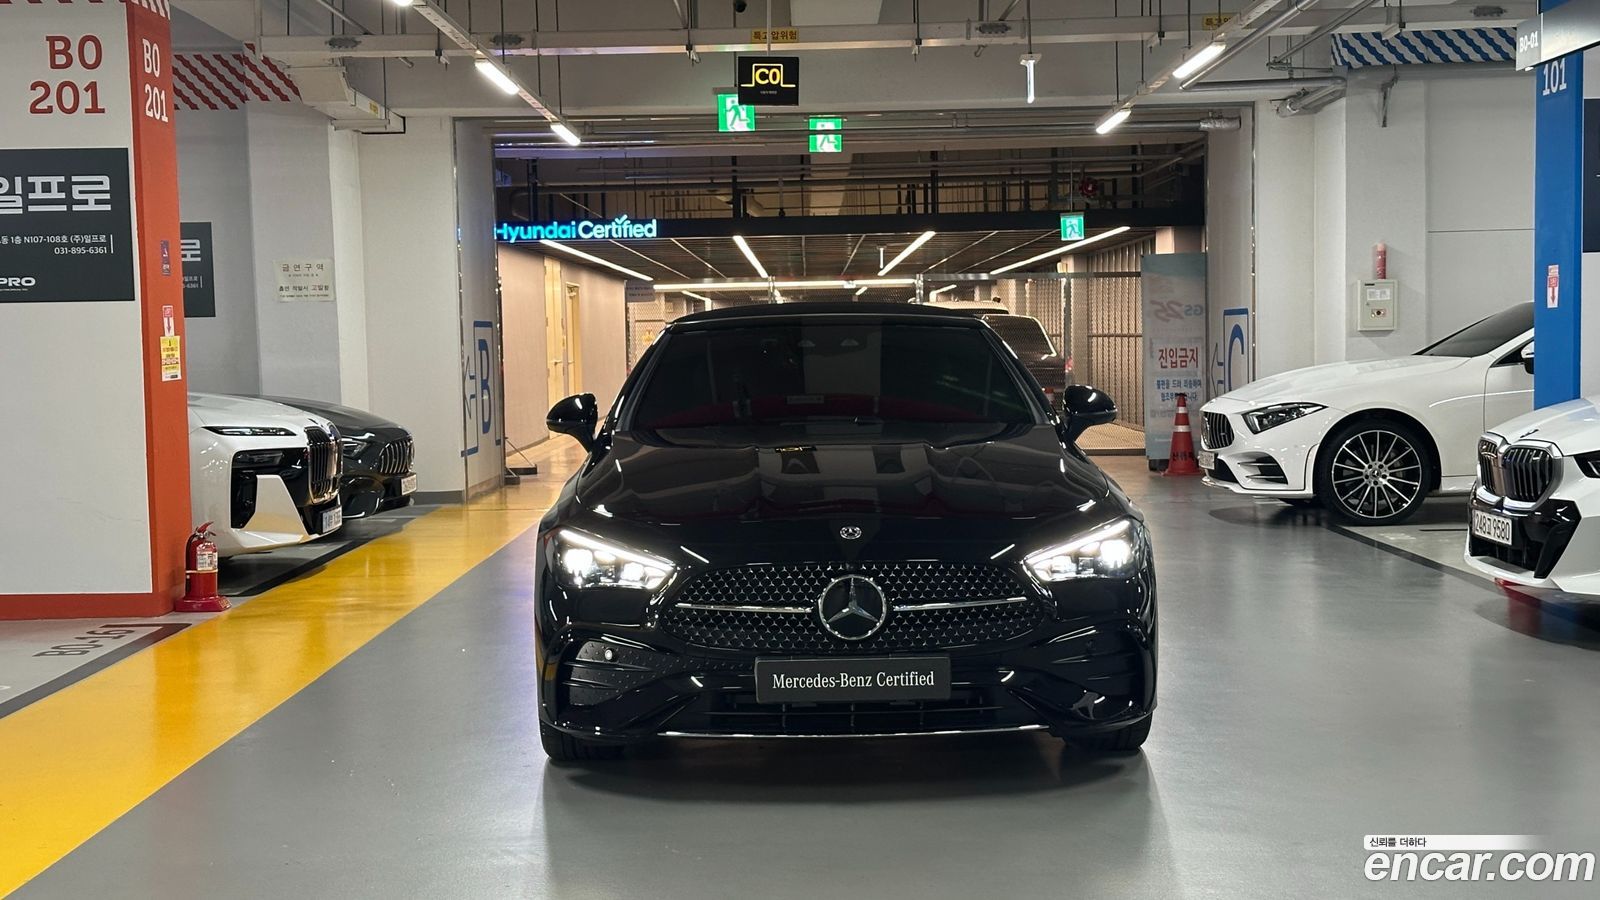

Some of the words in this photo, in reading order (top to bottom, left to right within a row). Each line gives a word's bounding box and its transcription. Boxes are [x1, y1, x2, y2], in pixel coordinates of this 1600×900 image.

[1542, 57, 1567, 96] 101
[29, 80, 106, 114] 201
[144, 84, 168, 122] 201
[0, 175, 112, 214] 일프로
[23, 235, 69, 243] N107-108호
[70, 234, 107, 243] (주)일프로
[494, 221, 577, 243] Hyundai
[578, 216, 657, 239] Certified
[54, 246, 107, 254] 031-895-6361
[1158, 347, 1199, 369] 진입금지
[478, 339, 491, 434] B
[772, 672, 873, 689] Mercedes-Benz
[876, 671, 935, 687] Certified
